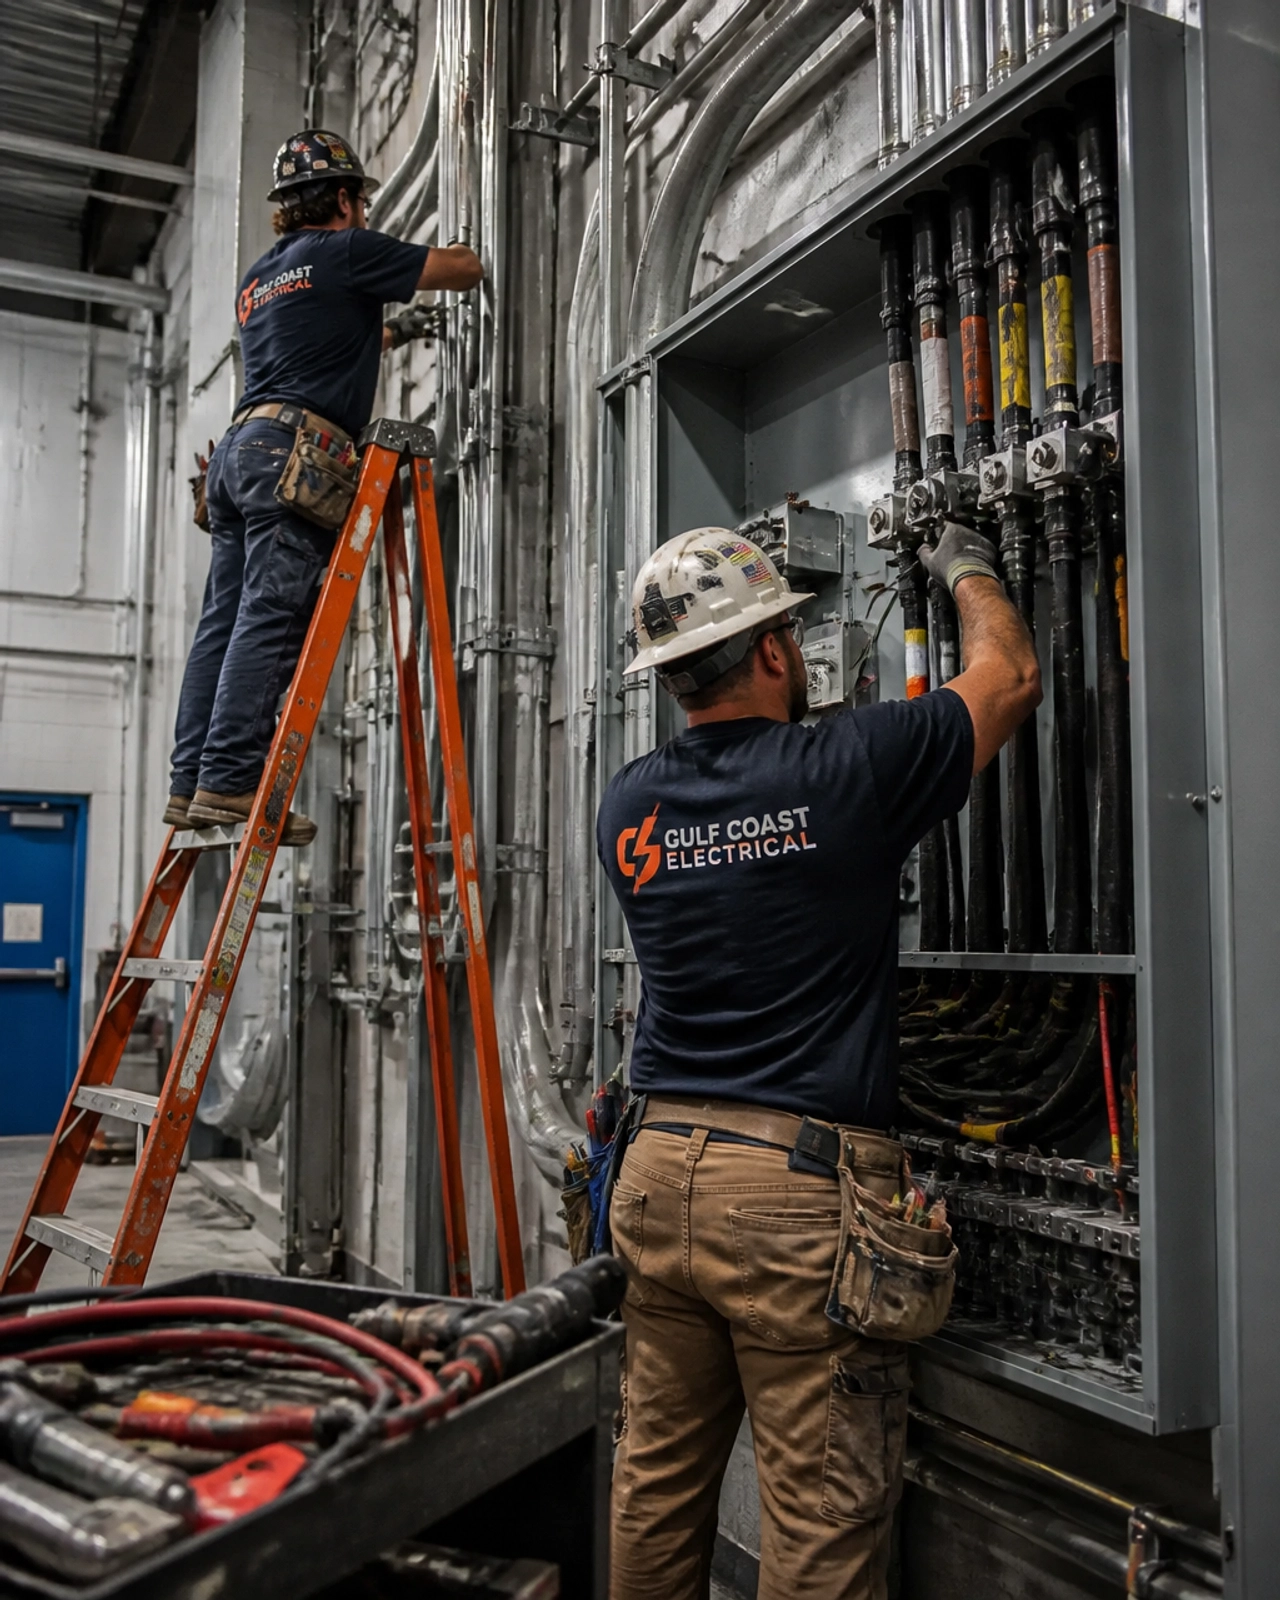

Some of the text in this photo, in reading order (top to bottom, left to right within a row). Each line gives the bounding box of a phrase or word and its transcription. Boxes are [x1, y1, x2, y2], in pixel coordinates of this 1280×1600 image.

[274, 265, 313, 286] COAST
[664, 806, 810, 848] GULF COAST
[666, 831, 817, 870] ELECTRICAL
